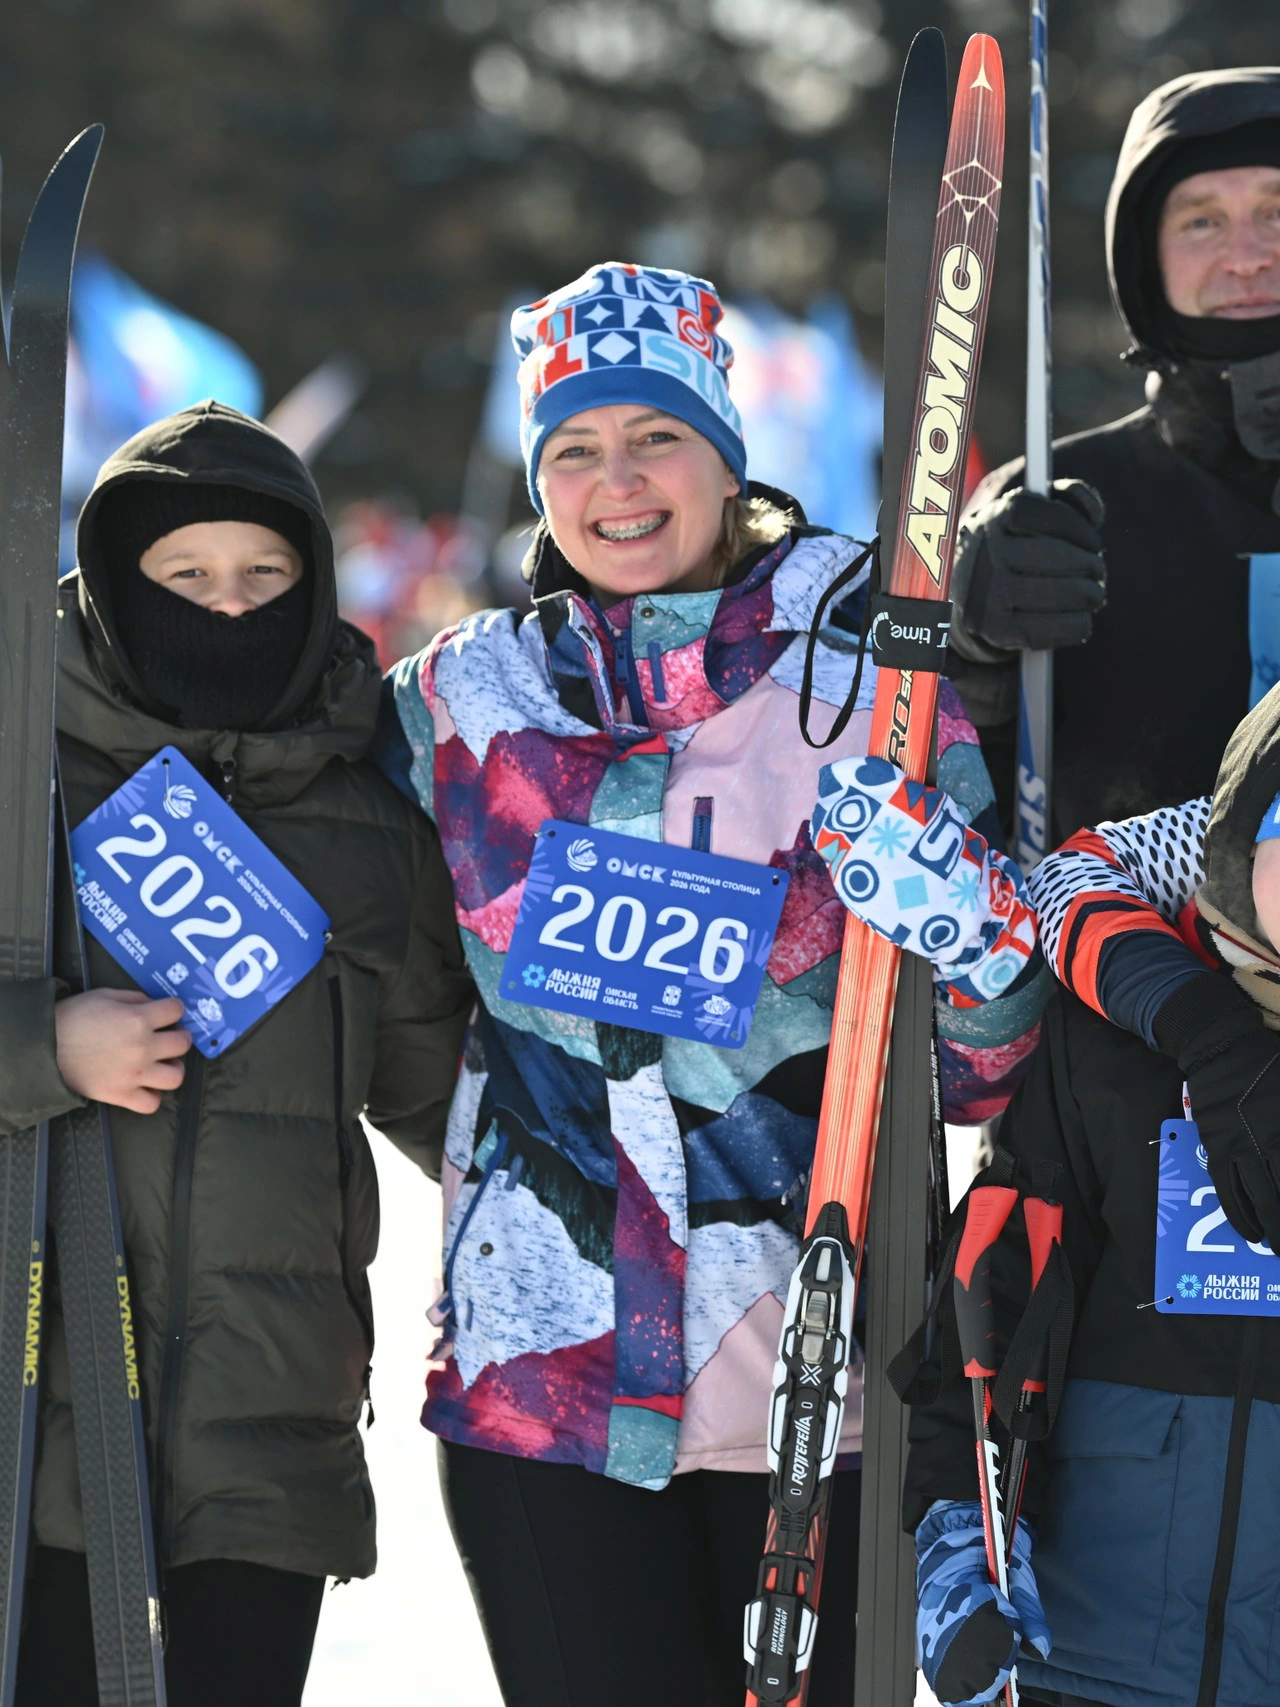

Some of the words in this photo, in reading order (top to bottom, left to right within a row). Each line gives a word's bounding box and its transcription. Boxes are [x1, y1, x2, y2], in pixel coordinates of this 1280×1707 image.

[905, 244, 984, 589] ATOMIC
[890, 624, 932, 645] time
[193, 821, 244, 876] ОМСК
[606, 857, 667, 884] ОМСК
[671, 869, 721, 887] КУЛЬТУРНАЯ
[722, 880, 761, 896] СТОЛИЦА
[84, 880, 128, 925] ЛЫЖНЯ
[96, 814, 278, 999] 2026
[689, 884, 711, 895] ГОДА
[538, 884, 749, 984] 2026
[545, 980, 598, 1002] РОССИИ
[548, 968, 602, 990] ЛЫЖНЯ
[1203, 1287, 1260, 1301] РОССИИ
[1204, 1274, 1260, 1288] ЛЫЖНЯ
[23, 1261, 43, 1387] DYNAMIC
[116, 1275, 140, 1400] DYNAMIC
[776, 1610, 789, 1656] TECHNOLOGY
